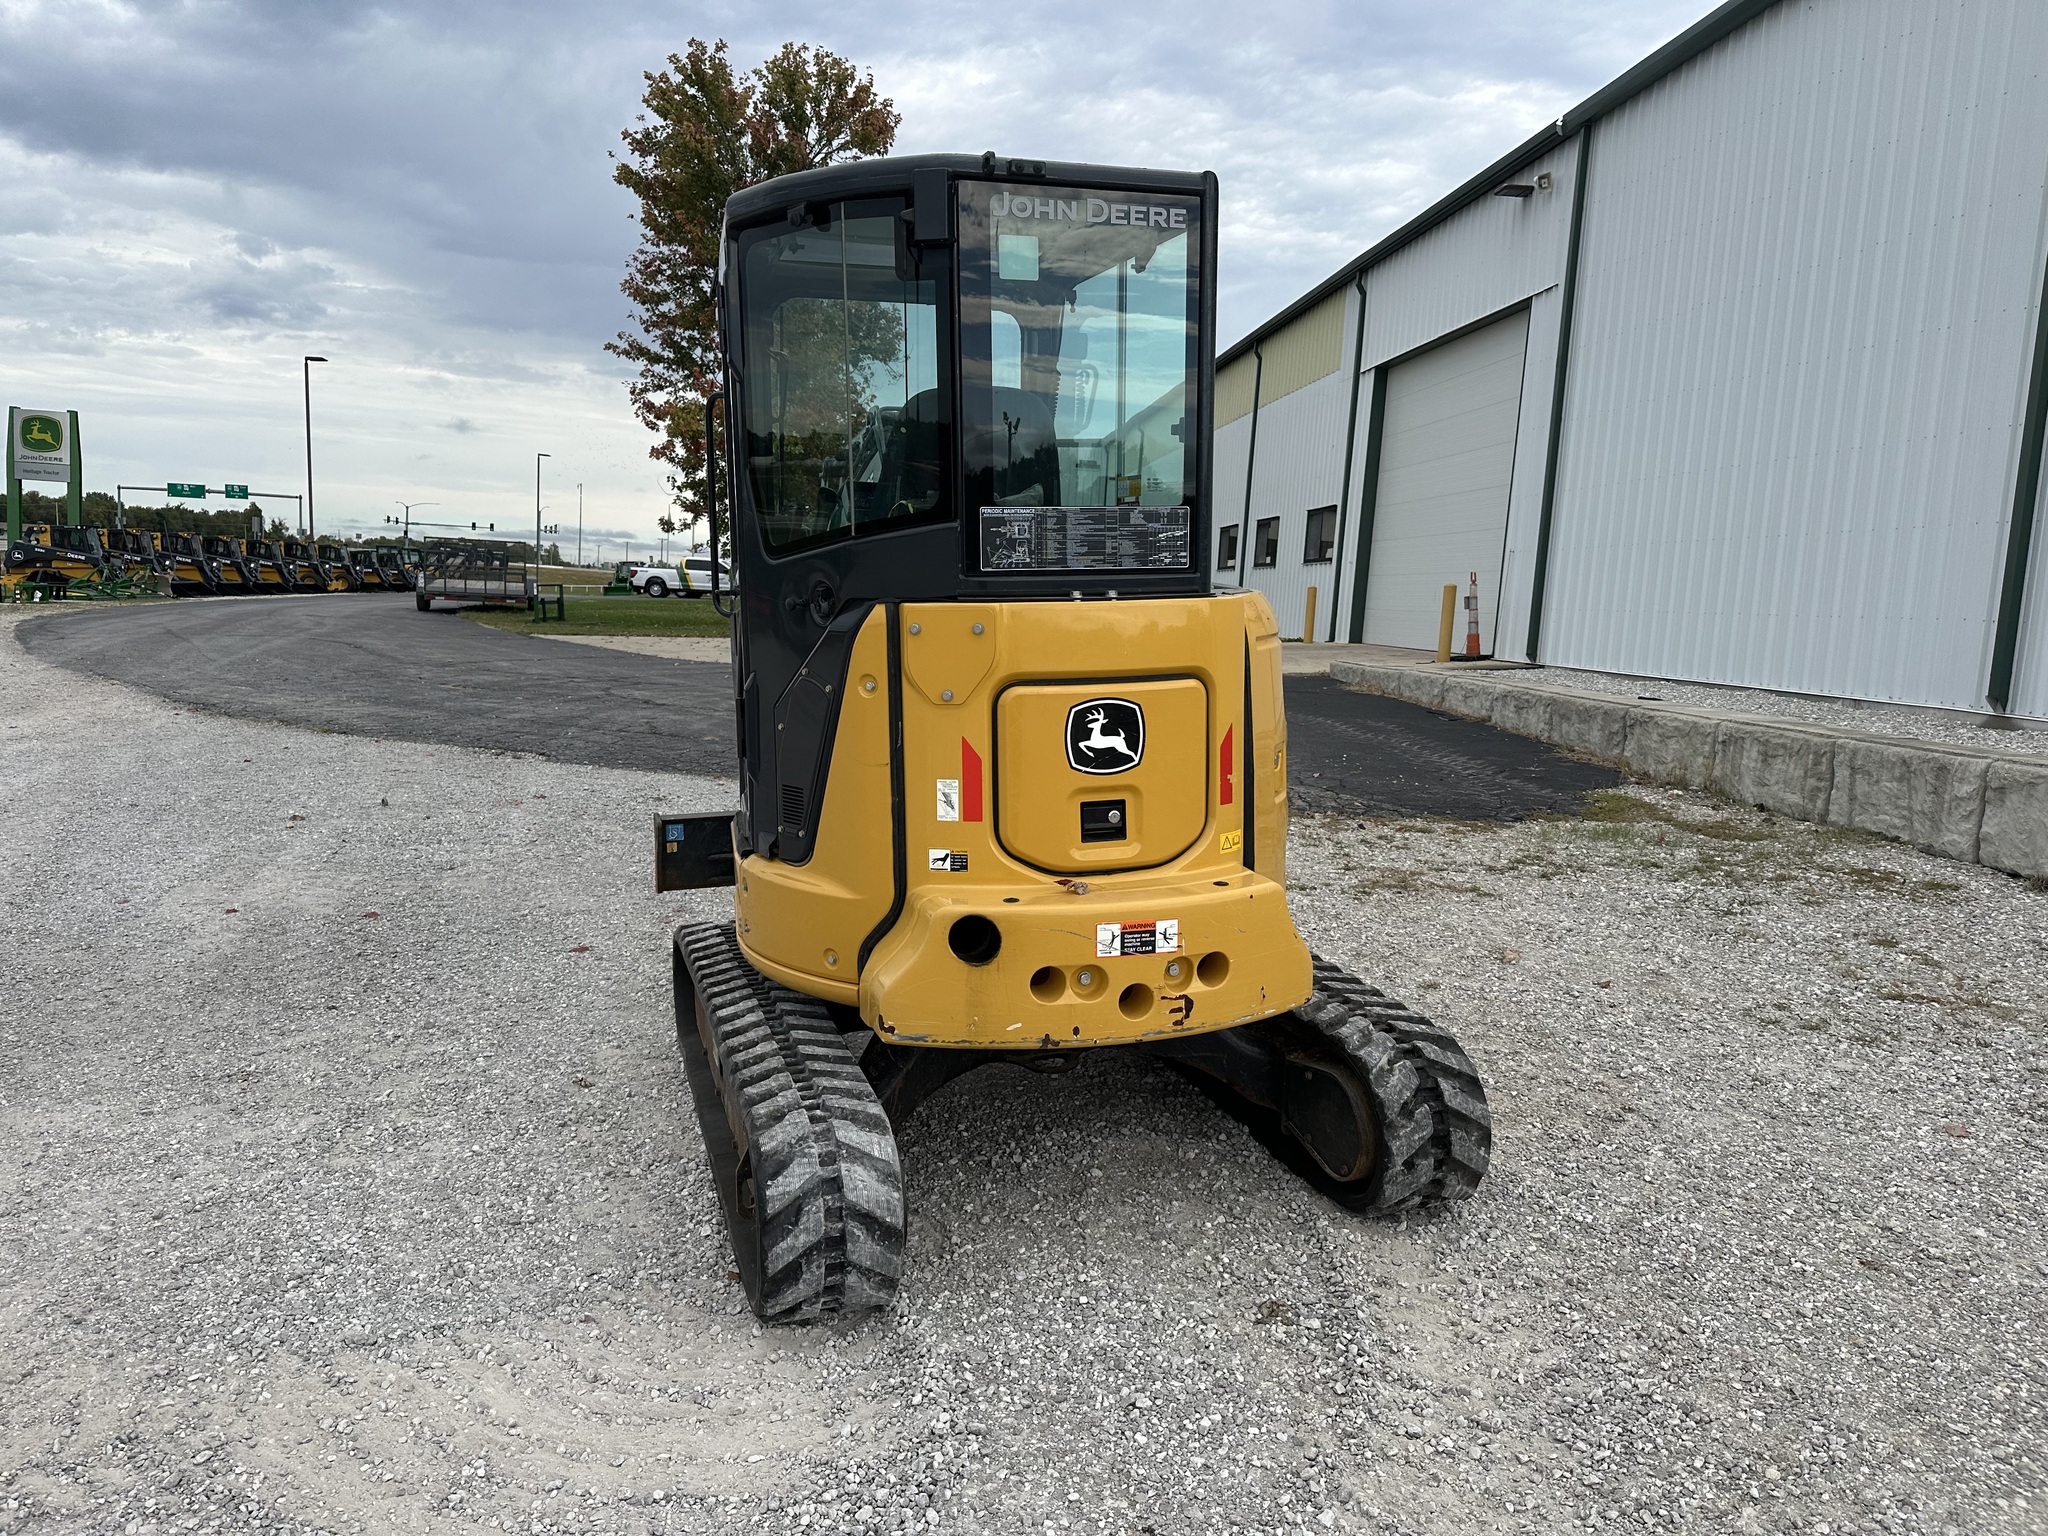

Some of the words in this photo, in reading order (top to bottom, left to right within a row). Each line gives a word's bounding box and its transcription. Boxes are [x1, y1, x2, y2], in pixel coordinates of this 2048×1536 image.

[992, 191, 1078, 222] JOHN
[1086, 198, 1187, 229] DEERE
[67, 552, 86, 561] DEERE
[175, 555, 192, 563] DEERE
